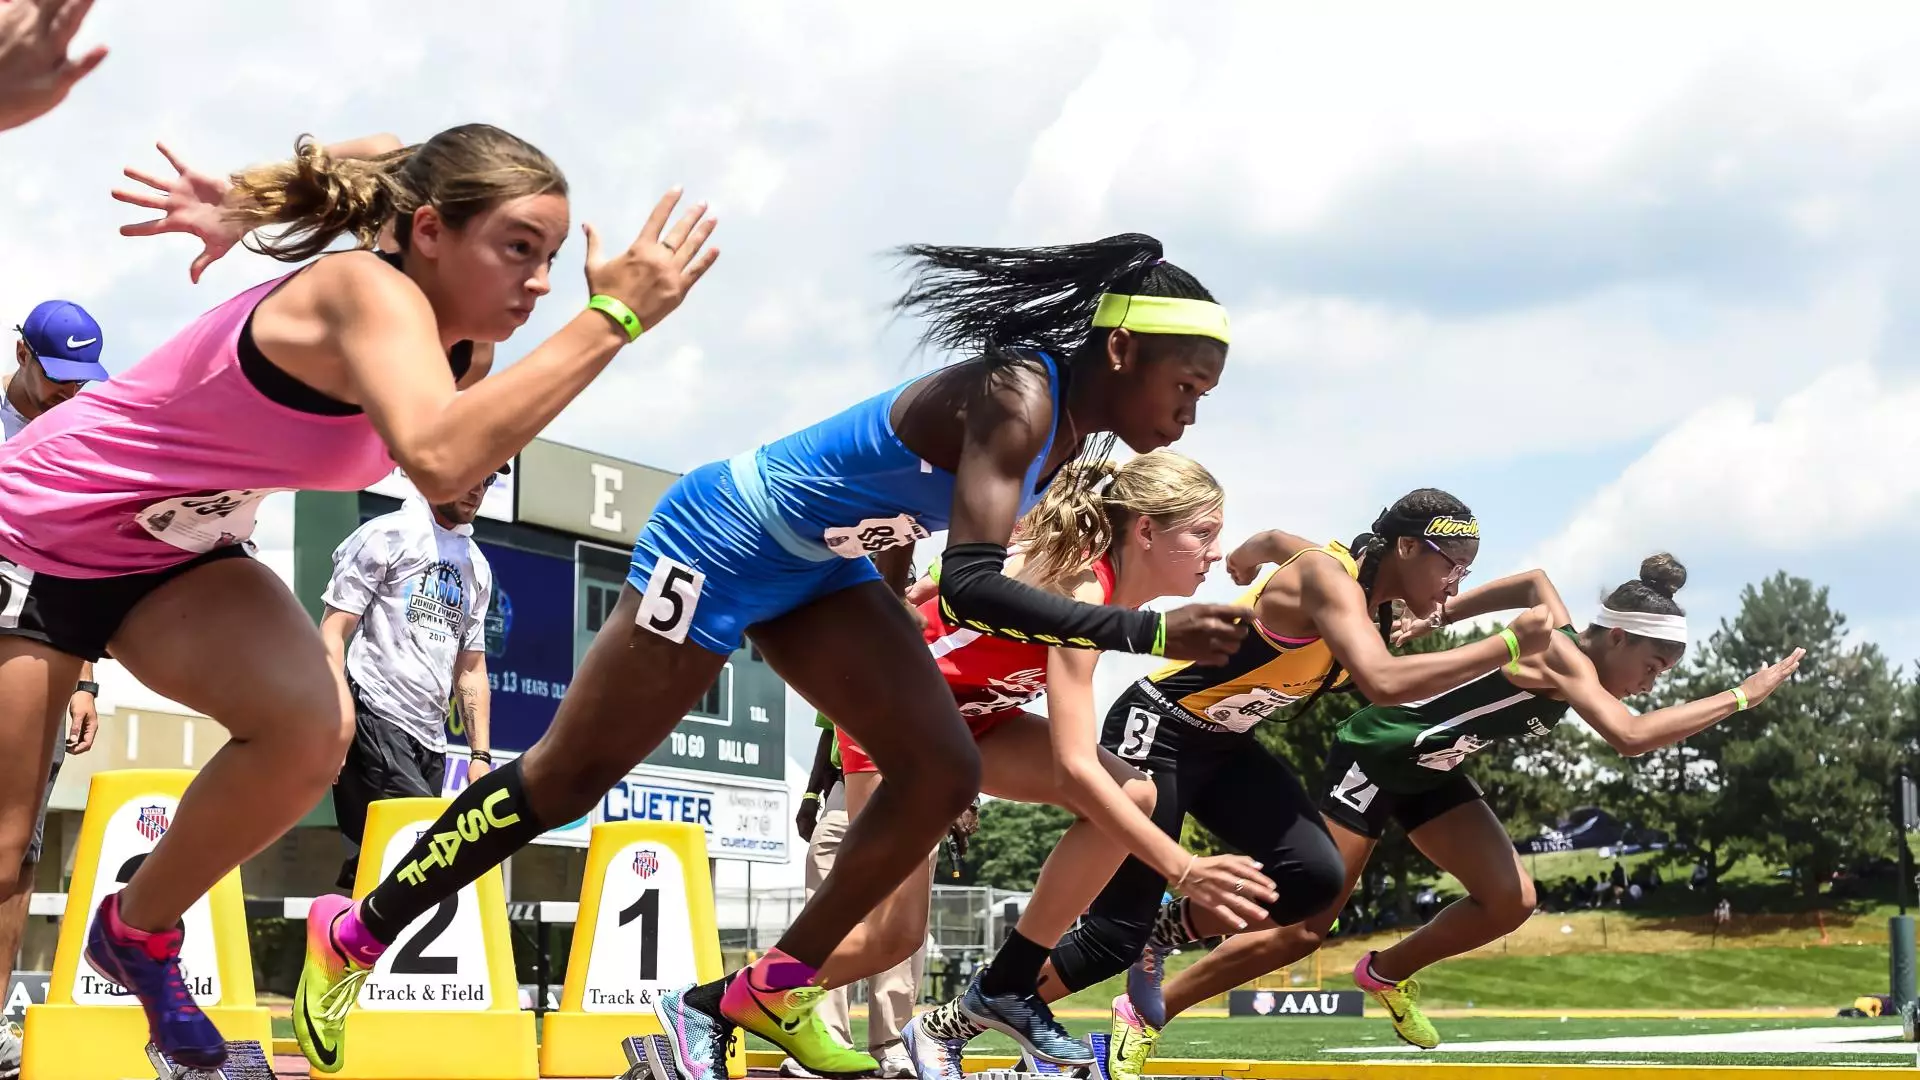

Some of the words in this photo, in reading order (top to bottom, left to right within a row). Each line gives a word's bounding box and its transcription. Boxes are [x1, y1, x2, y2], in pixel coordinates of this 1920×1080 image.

[590, 463, 623, 532] E
[1425, 516, 1480, 537] Hurdl
[648, 565, 694, 632] 5
[501, 671, 518, 692] 13
[1170, 706, 1203, 728] ARMOUR
[1123, 712, 1149, 755] 3
[397, 787, 520, 887] USATF
[389, 891, 458, 975] 2
[618, 888, 660, 980] 1
[366, 983, 417, 1001] Track
[422, 984, 436, 1001] &
[441, 983, 485, 1001] Field
[588, 988, 635, 1005] Track
[640, 989, 652, 1005] &
[1279, 993, 1340, 1014] AAU
